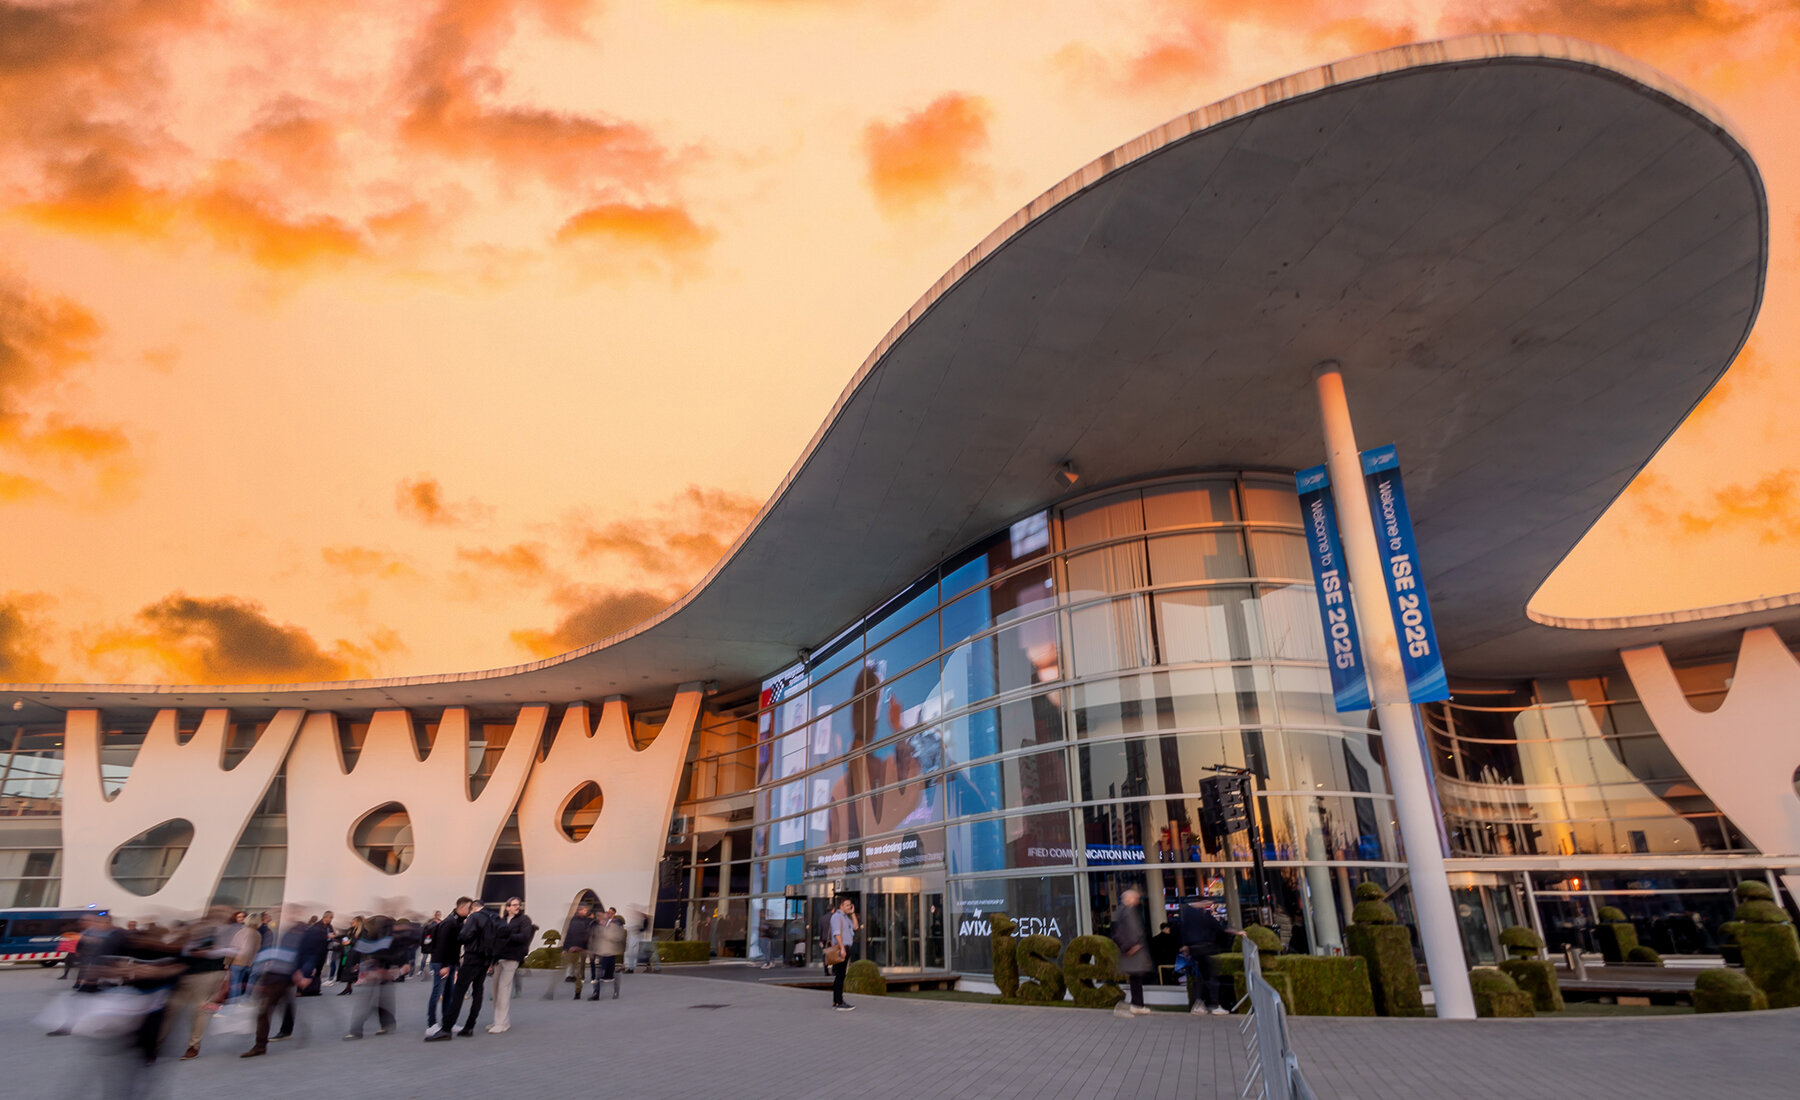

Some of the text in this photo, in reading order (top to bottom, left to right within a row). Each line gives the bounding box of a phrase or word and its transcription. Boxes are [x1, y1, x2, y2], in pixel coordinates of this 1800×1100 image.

[1311, 499, 1329, 553] Welcome
[1379, 480, 1399, 537] Welcome
[1321, 553, 1332, 567] to
[1389, 537, 1402, 551] to
[1321, 569, 1343, 606] ISE
[1391, 554, 1416, 592] ISE
[1328, 608, 1355, 669] 2025
[1399, 594, 1430, 658] 2025
[903, 840, 917, 850] soon
[1123, 850, 1132, 860] IN
